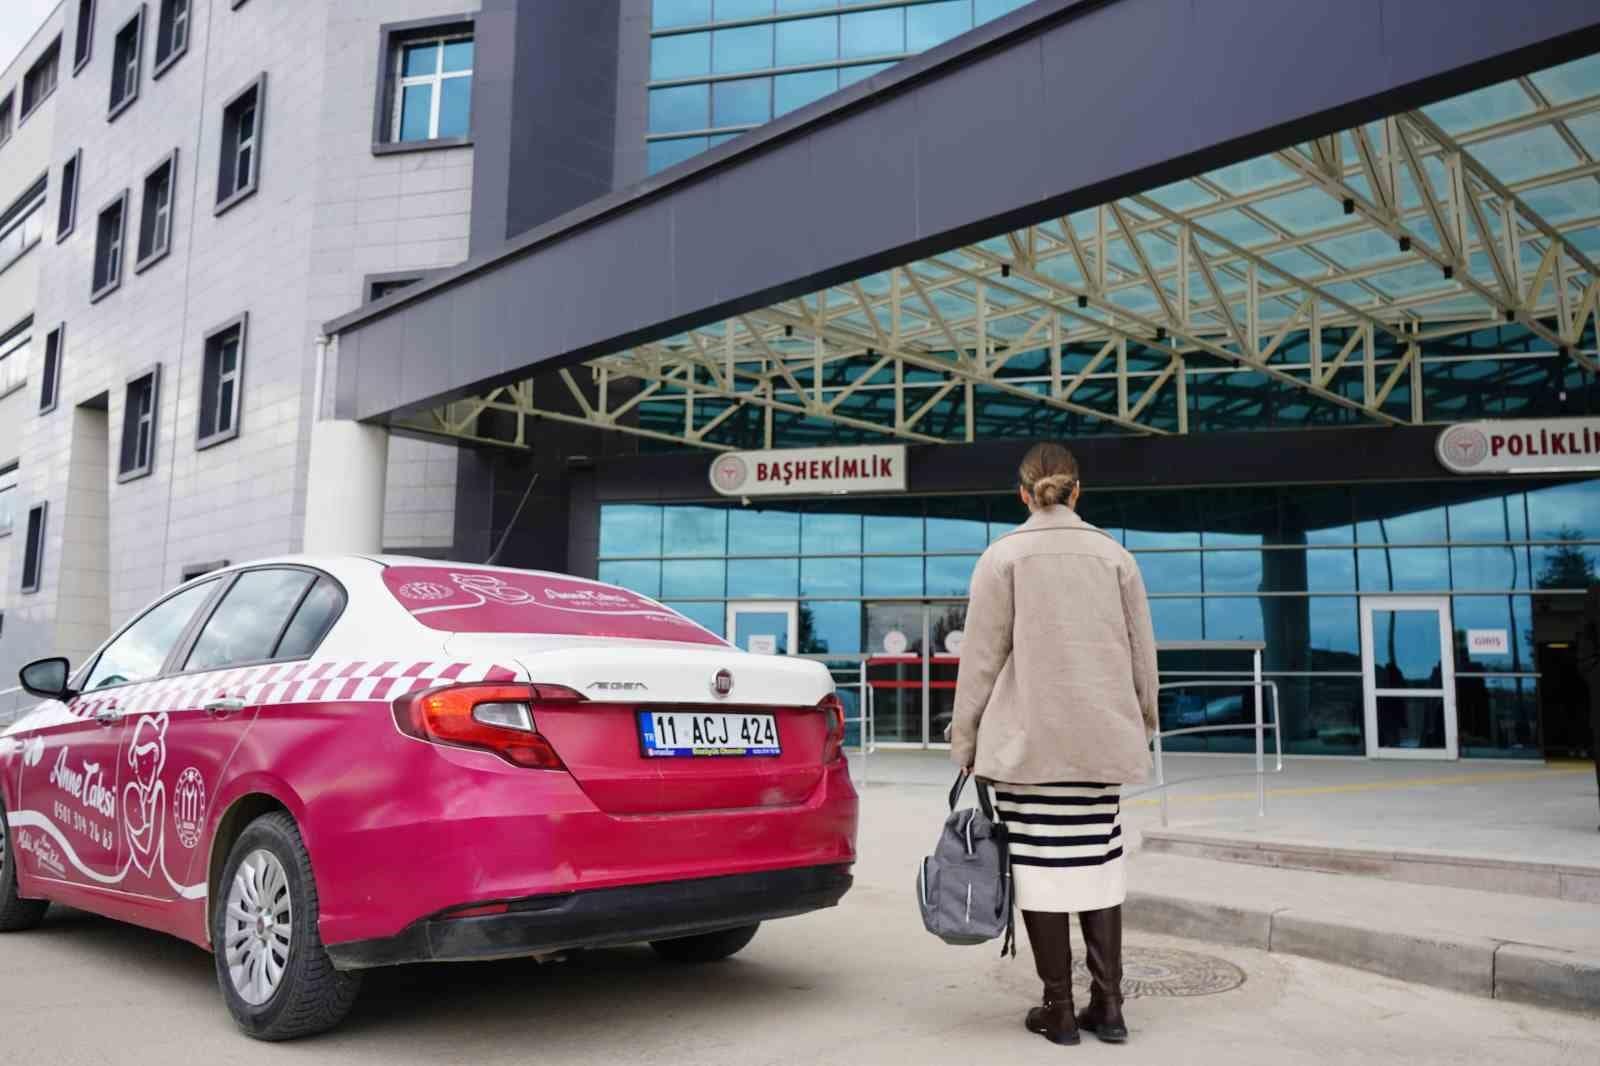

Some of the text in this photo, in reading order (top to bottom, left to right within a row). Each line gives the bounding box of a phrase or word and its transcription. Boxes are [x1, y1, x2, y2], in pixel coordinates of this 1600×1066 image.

[756, 454, 893, 486] BAŞHEKİMLİK
[657, 716, 774, 745] 11 ACJ 424
[49, 745, 82, 798] Anne
[83, 759, 116, 819] Taksi
